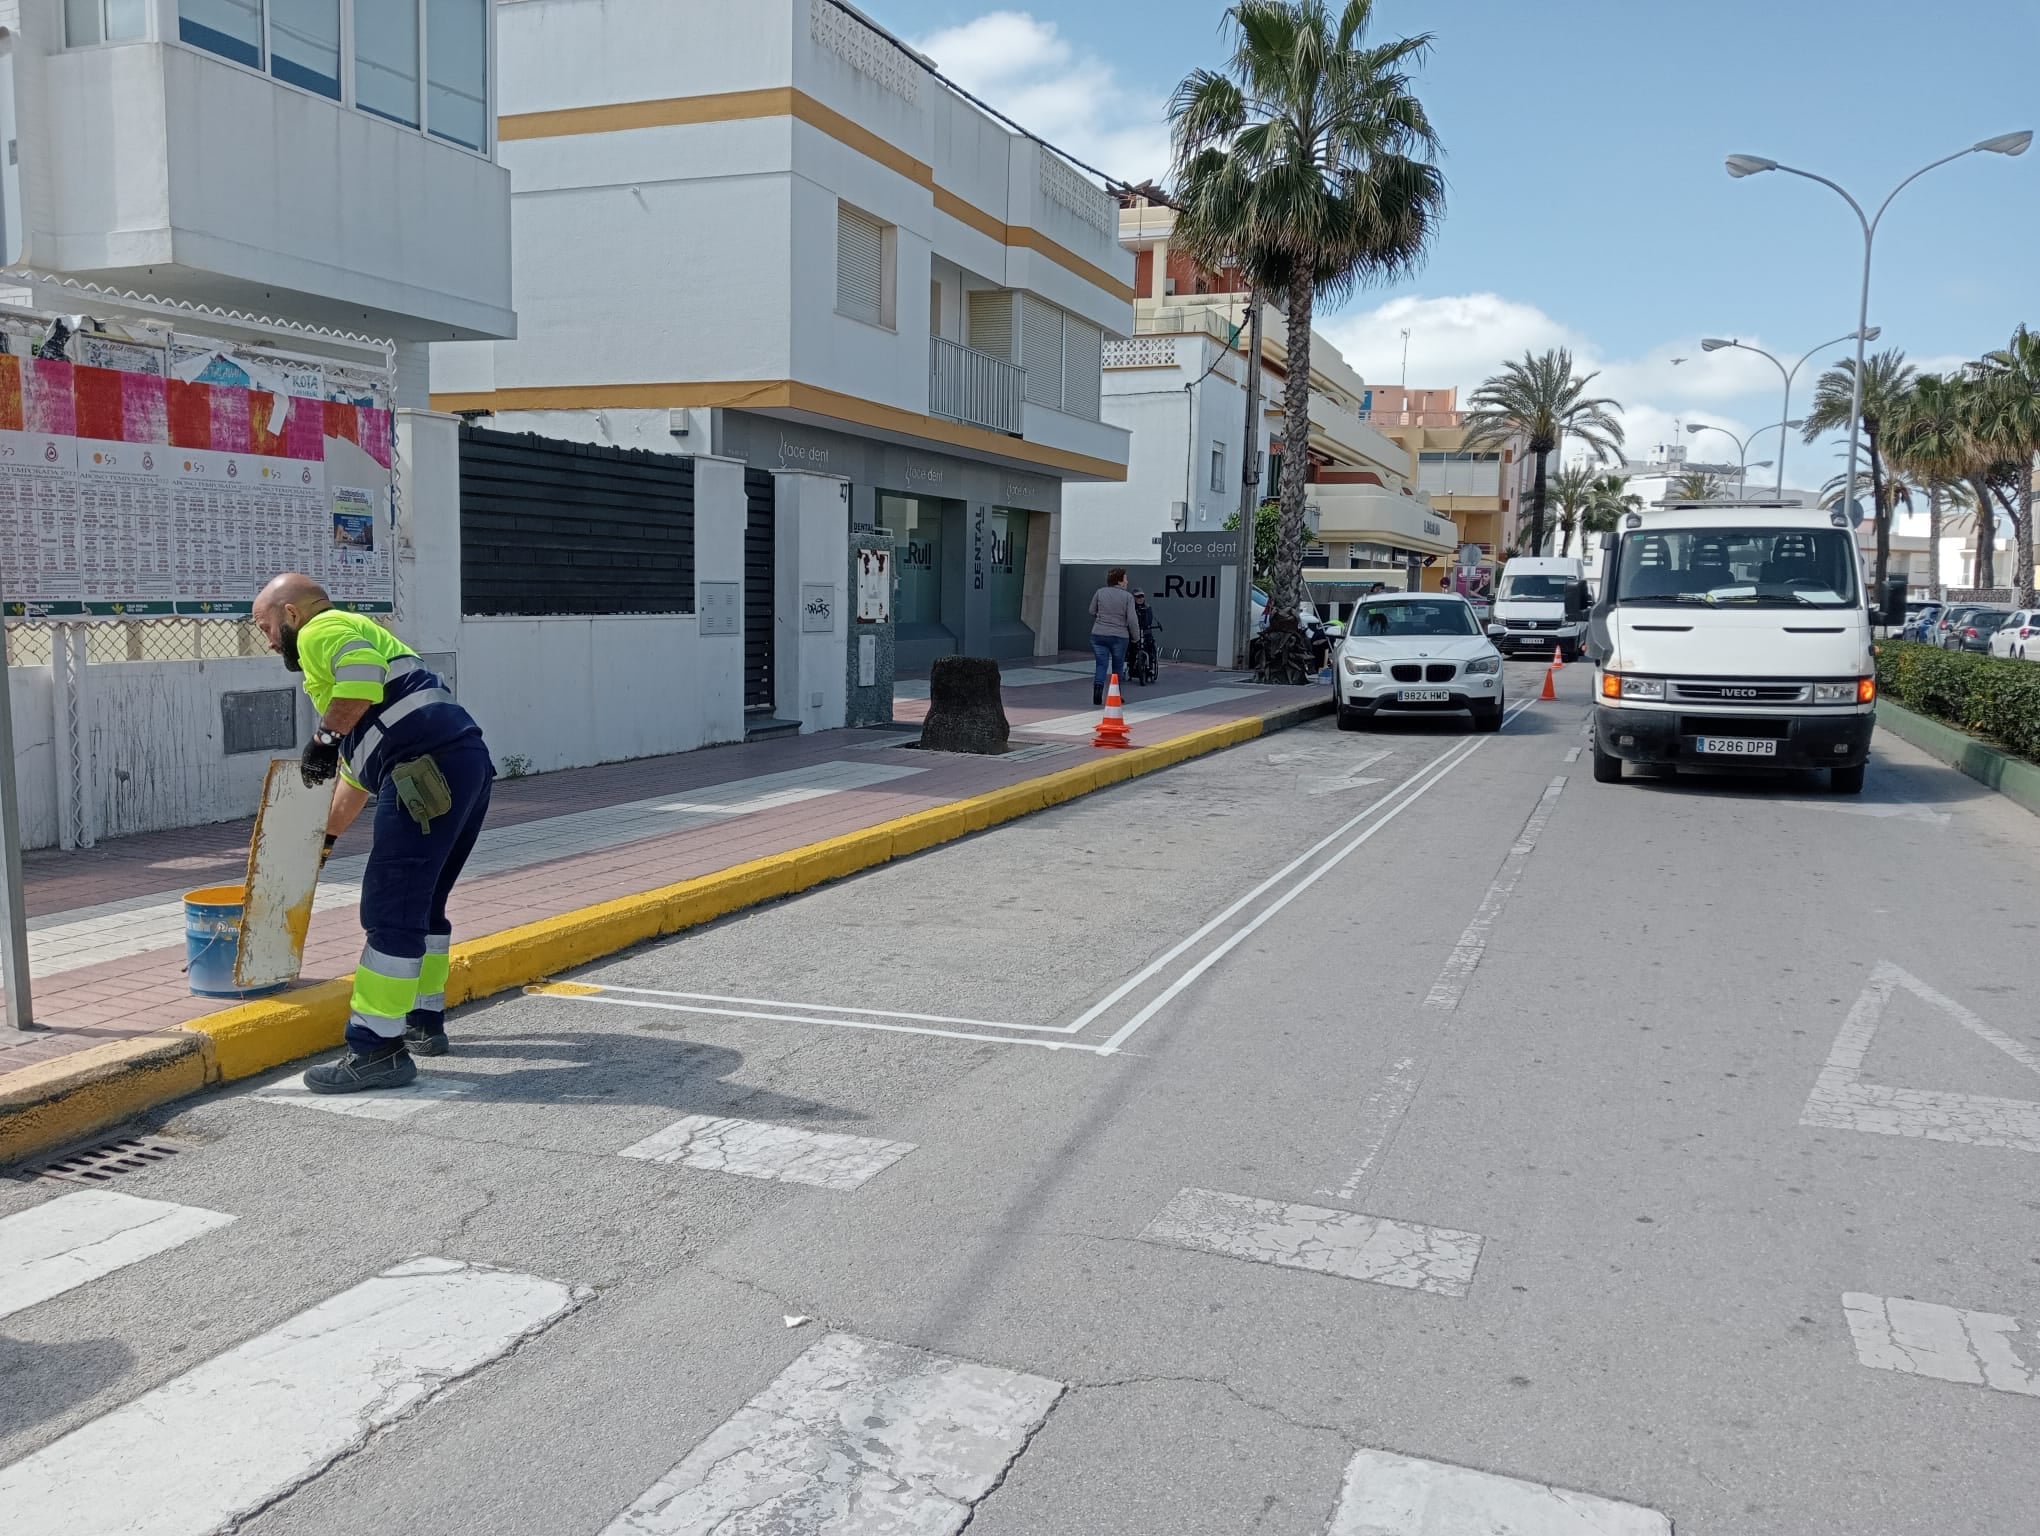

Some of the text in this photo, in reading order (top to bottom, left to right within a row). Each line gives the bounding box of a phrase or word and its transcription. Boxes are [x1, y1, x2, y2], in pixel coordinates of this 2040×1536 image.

[784, 440, 829, 463] face dent
[927, 467, 944, 482] dent
[854, 522, 874, 531] DENTAL
[974, 506, 984, 590] DENTAL
[1173, 541, 1237, 553] face dent
[1404, 691, 1448, 700] 9824 HMC
[1721, 688, 1757, 697] IVECO
[1708, 740, 1774, 753] 6286 DPB
